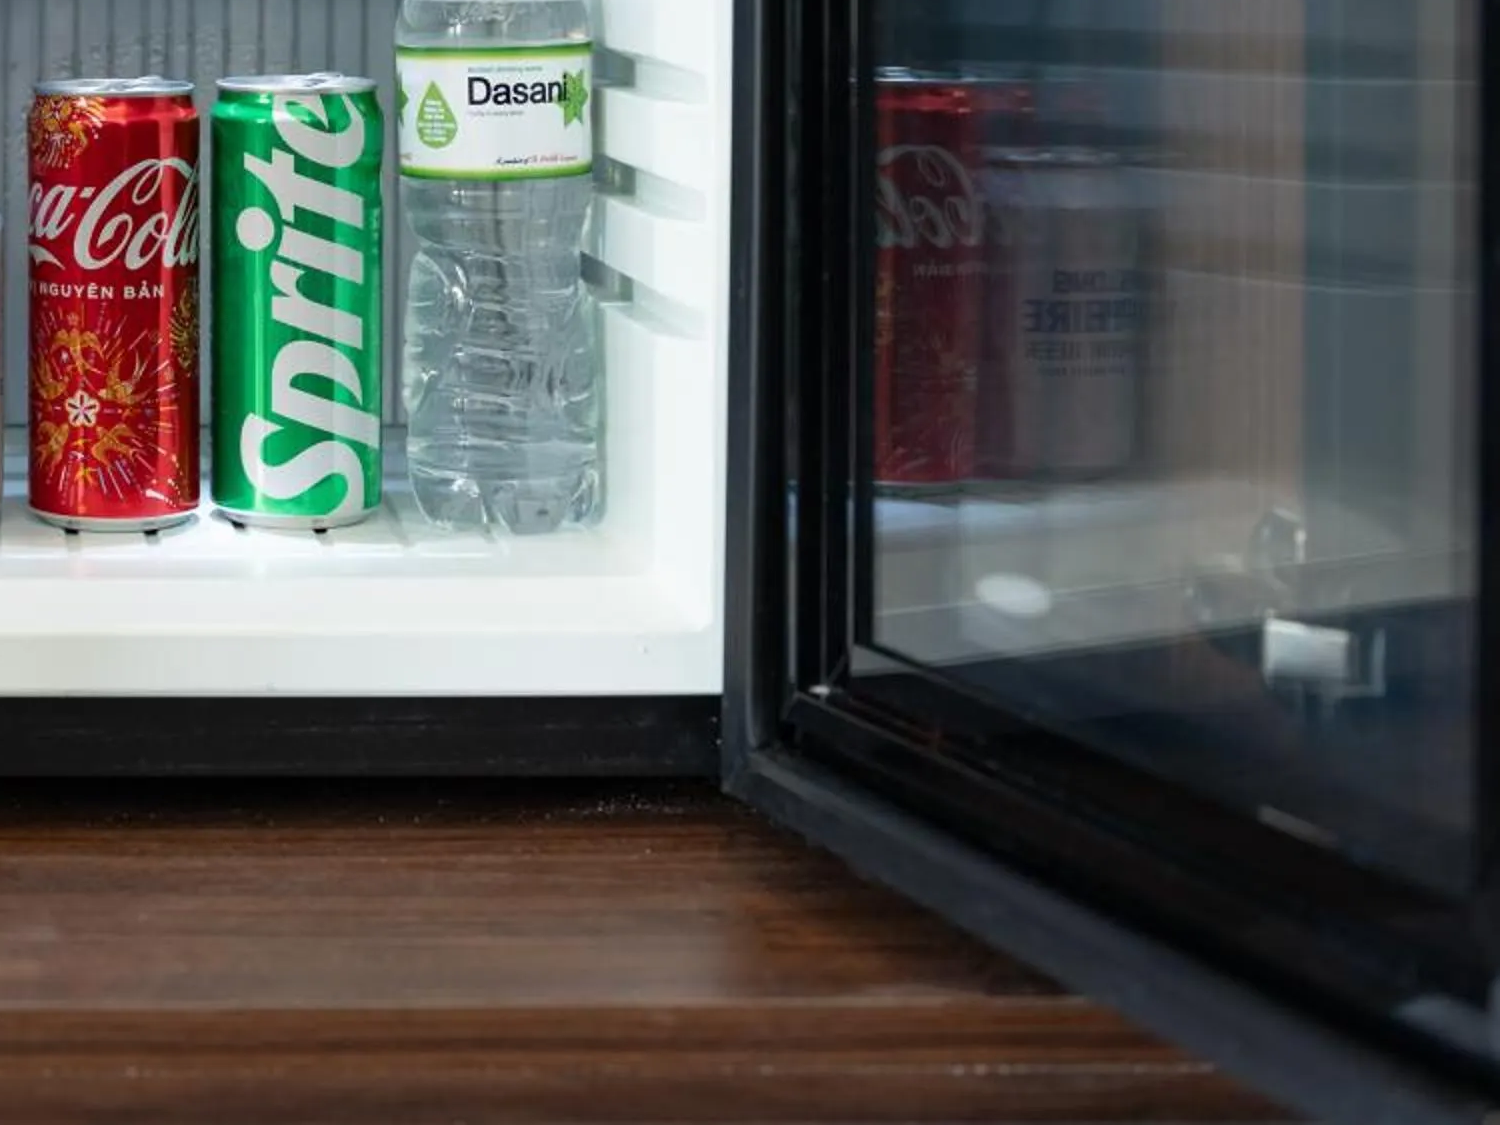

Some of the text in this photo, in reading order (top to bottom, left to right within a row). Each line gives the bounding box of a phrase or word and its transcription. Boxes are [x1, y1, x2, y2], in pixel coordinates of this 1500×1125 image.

[466, 72, 569, 106] Dasani
[38, 282, 115, 299] NGUYÊN
[122, 279, 166, 299] BẢN
[235, 93, 381, 519] Sprite
